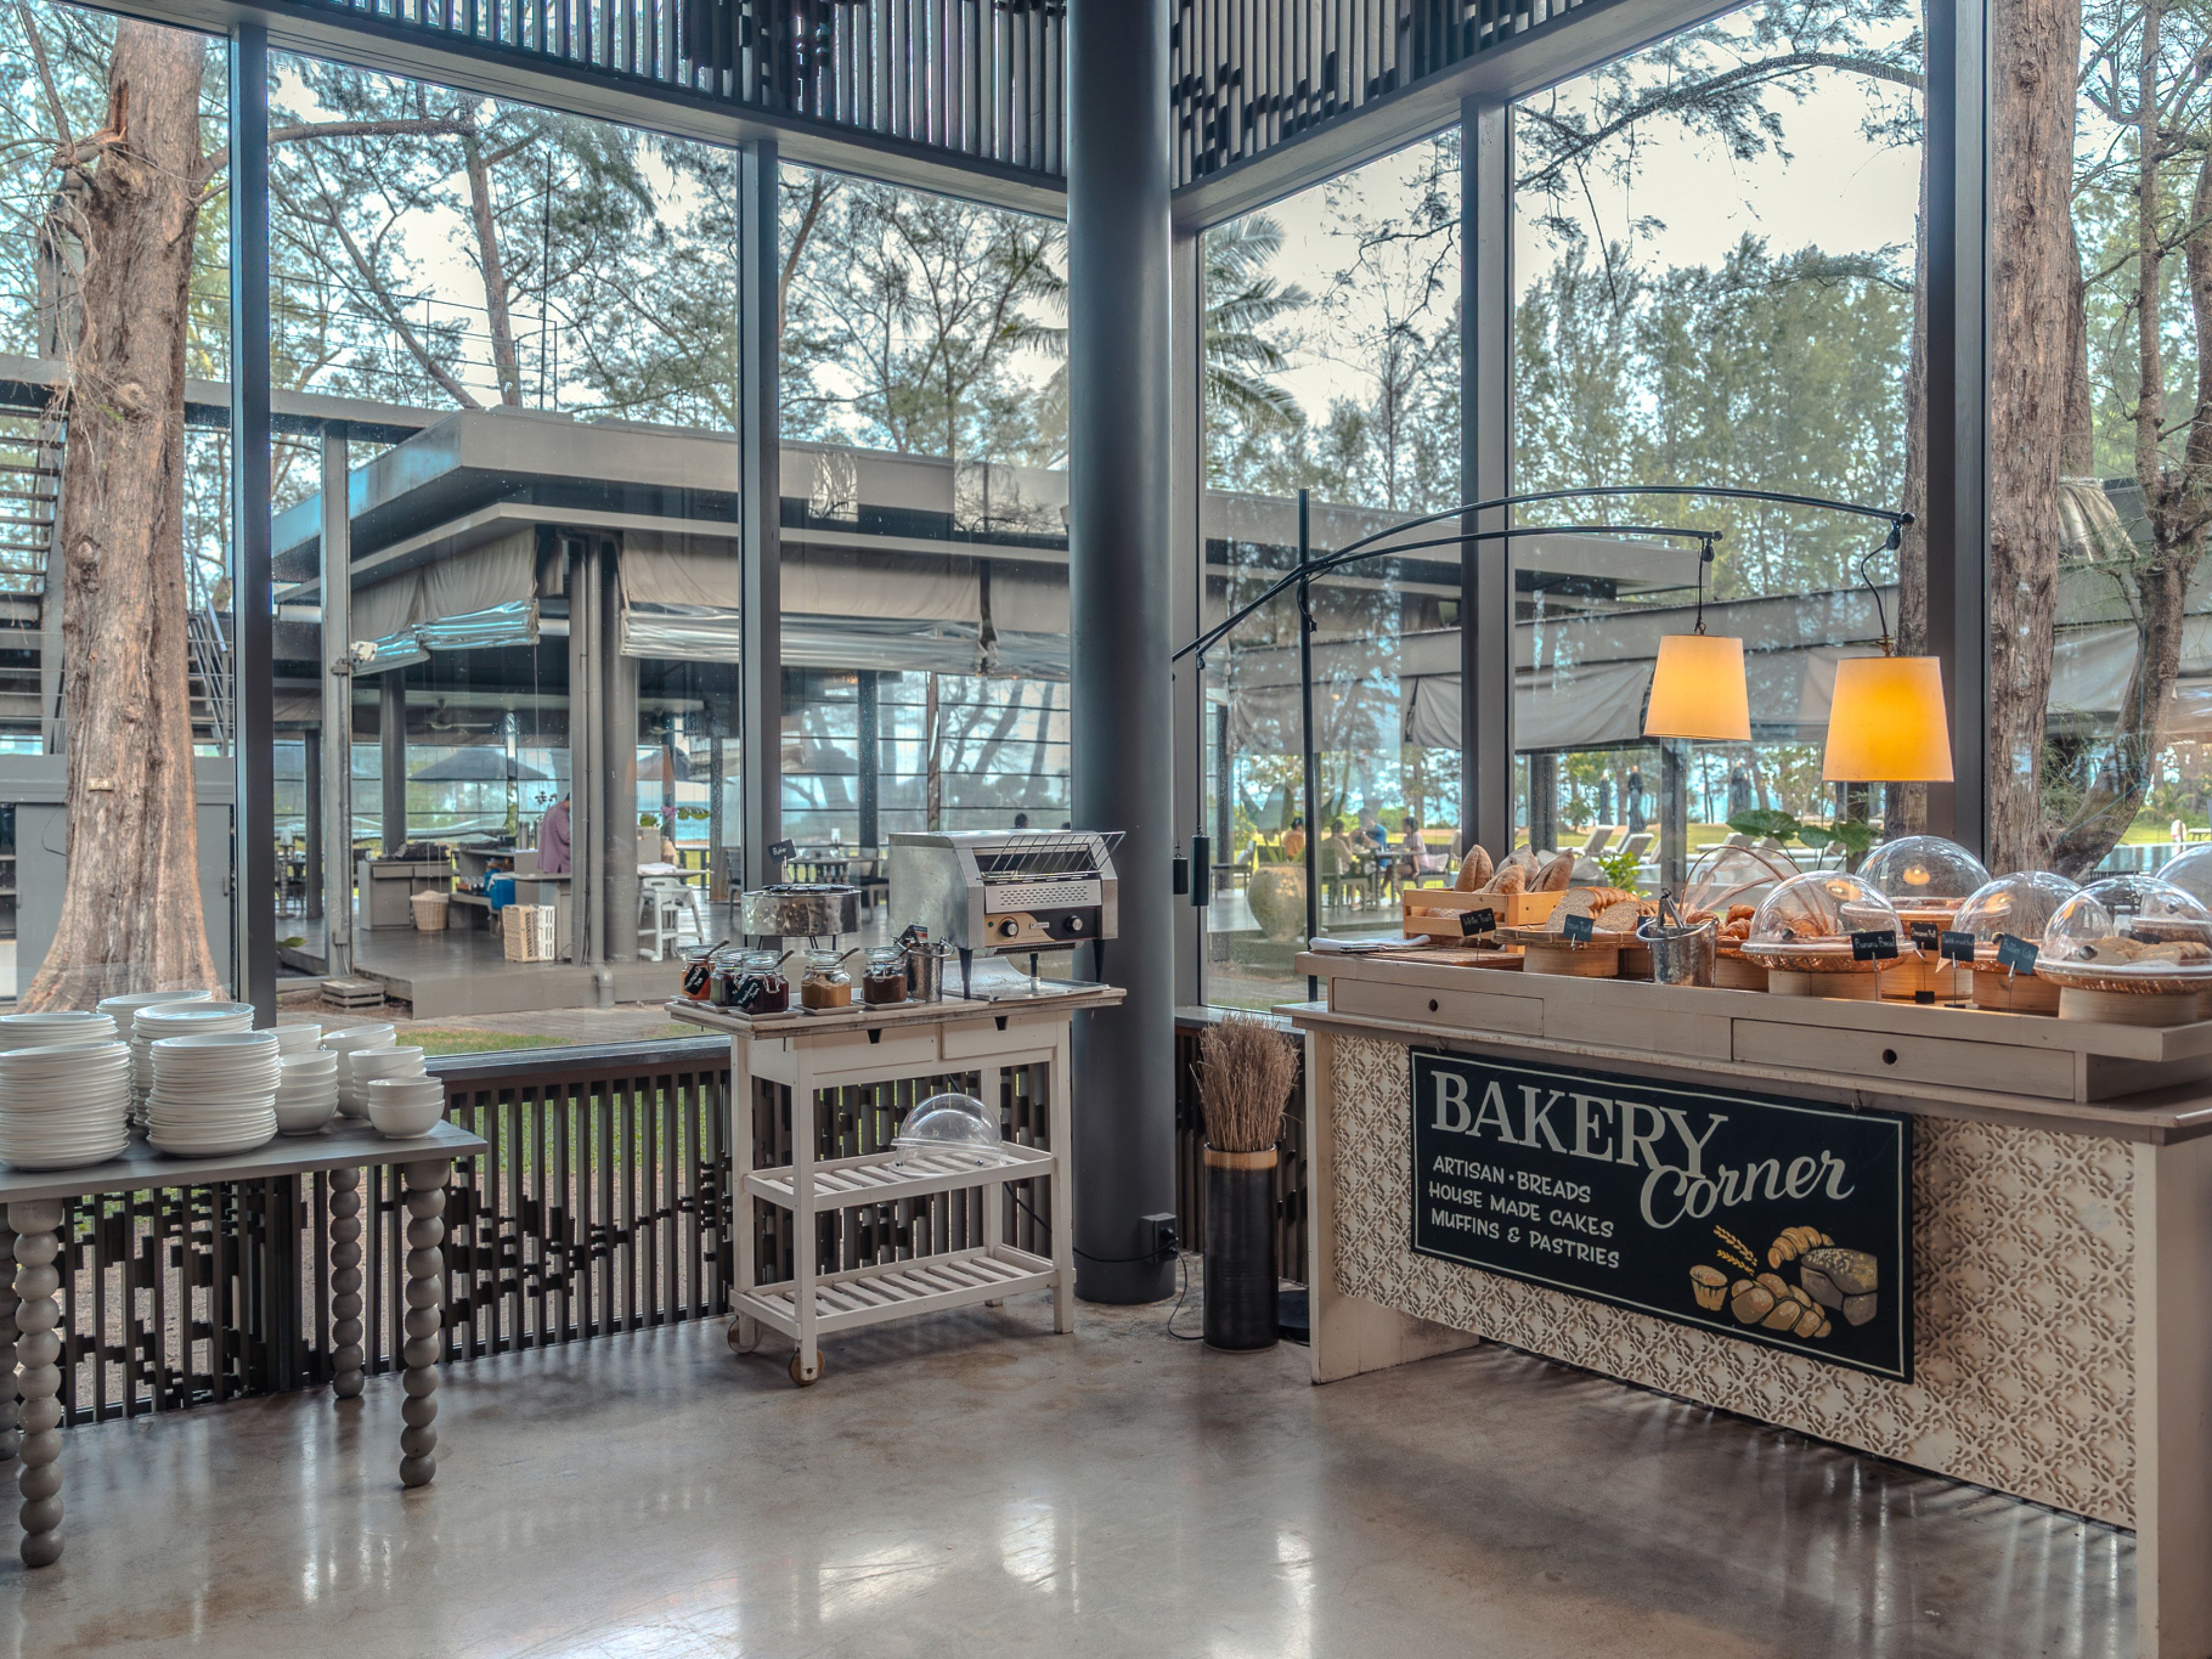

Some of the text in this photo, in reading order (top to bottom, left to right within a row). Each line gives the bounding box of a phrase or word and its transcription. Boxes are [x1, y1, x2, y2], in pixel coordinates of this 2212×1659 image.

[1854, 935, 1895, 949] Banana Bread
[750, 987, 760, 999] Jam
[1431, 1070, 1729, 1180] BAKERY
[1433, 1155, 1591, 1203] ARTISAN BREADS
[1639, 1149, 1855, 1229] Corner
[1429, 1180, 1614, 1238] HOUSE MADE CAKES
[1431, 1207, 1619, 1268] MUFFINS & PASTRIES
